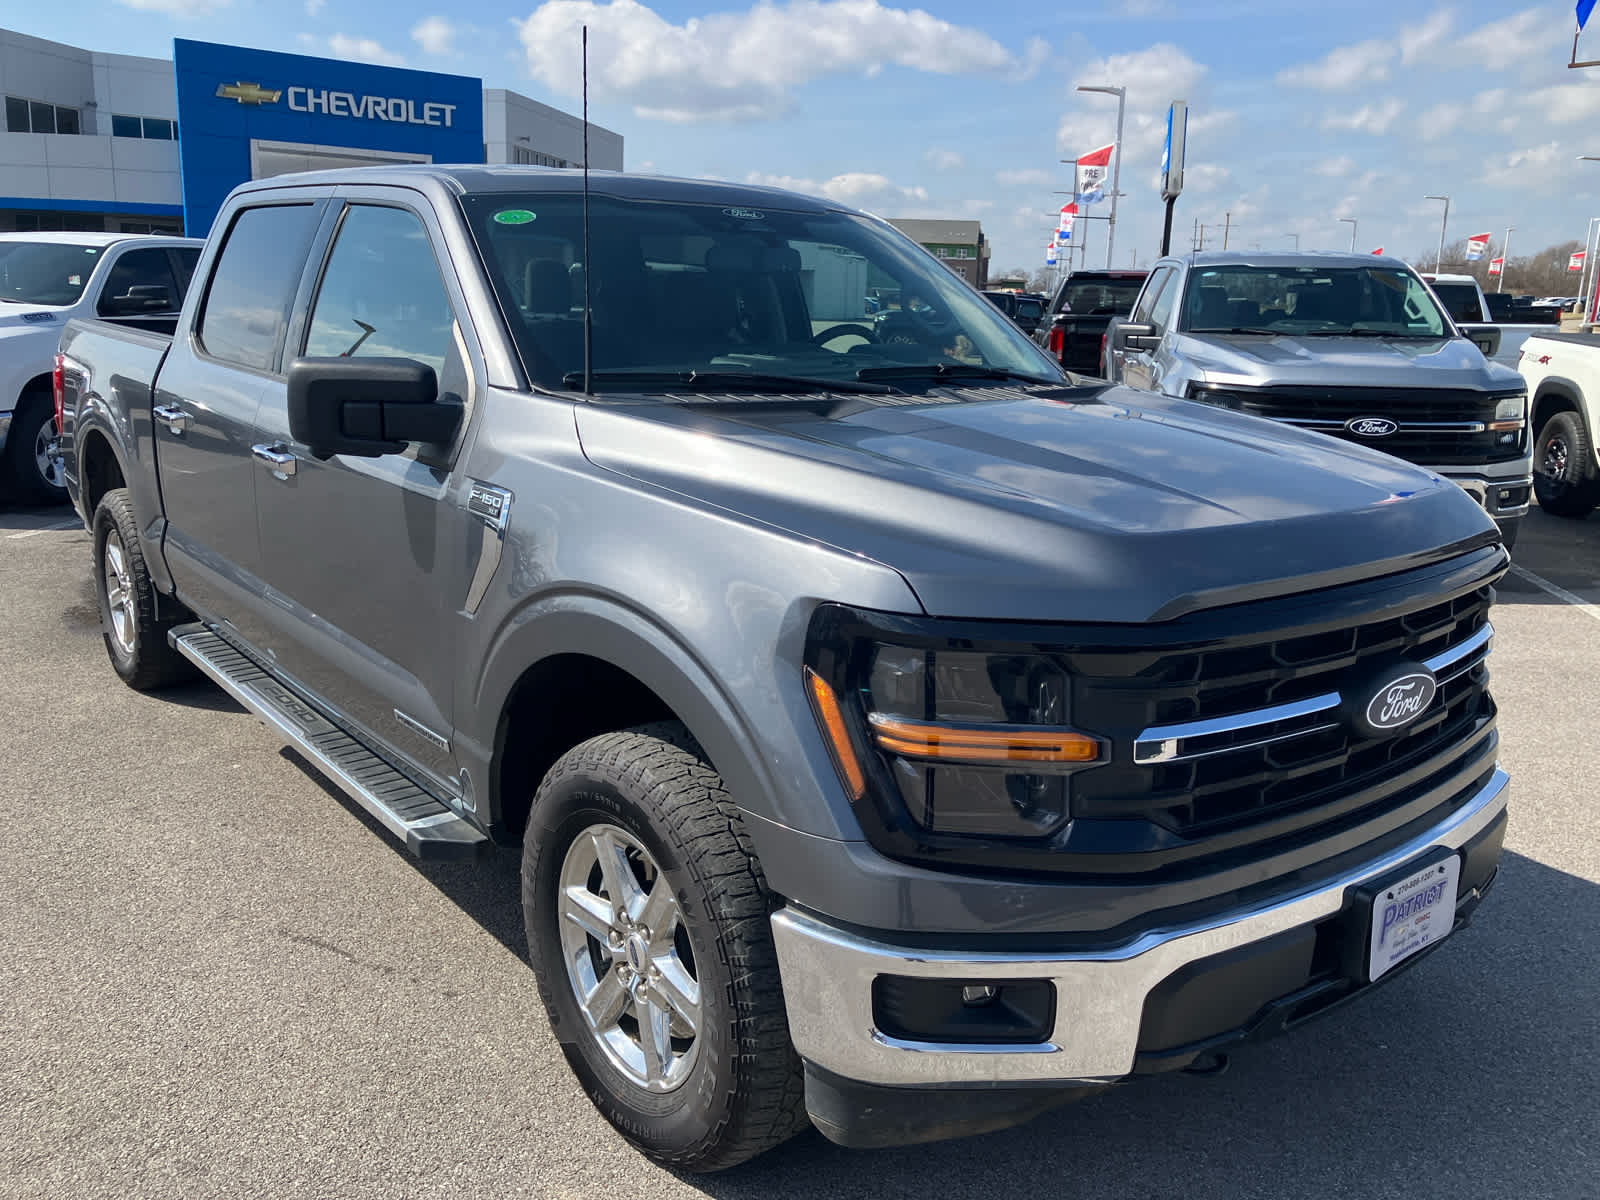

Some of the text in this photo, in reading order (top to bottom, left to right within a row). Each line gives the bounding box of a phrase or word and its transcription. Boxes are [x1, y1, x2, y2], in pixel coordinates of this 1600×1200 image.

[287, 86, 457, 127] CHEVROLET
[1084, 168, 1099, 178] PRE
[1358, 420, 1389, 433] Ford
[471, 488, 501, 508] F-150
[1381, 681, 1425, 722] Ford
[1380, 880, 1447, 945] PATRIOT
